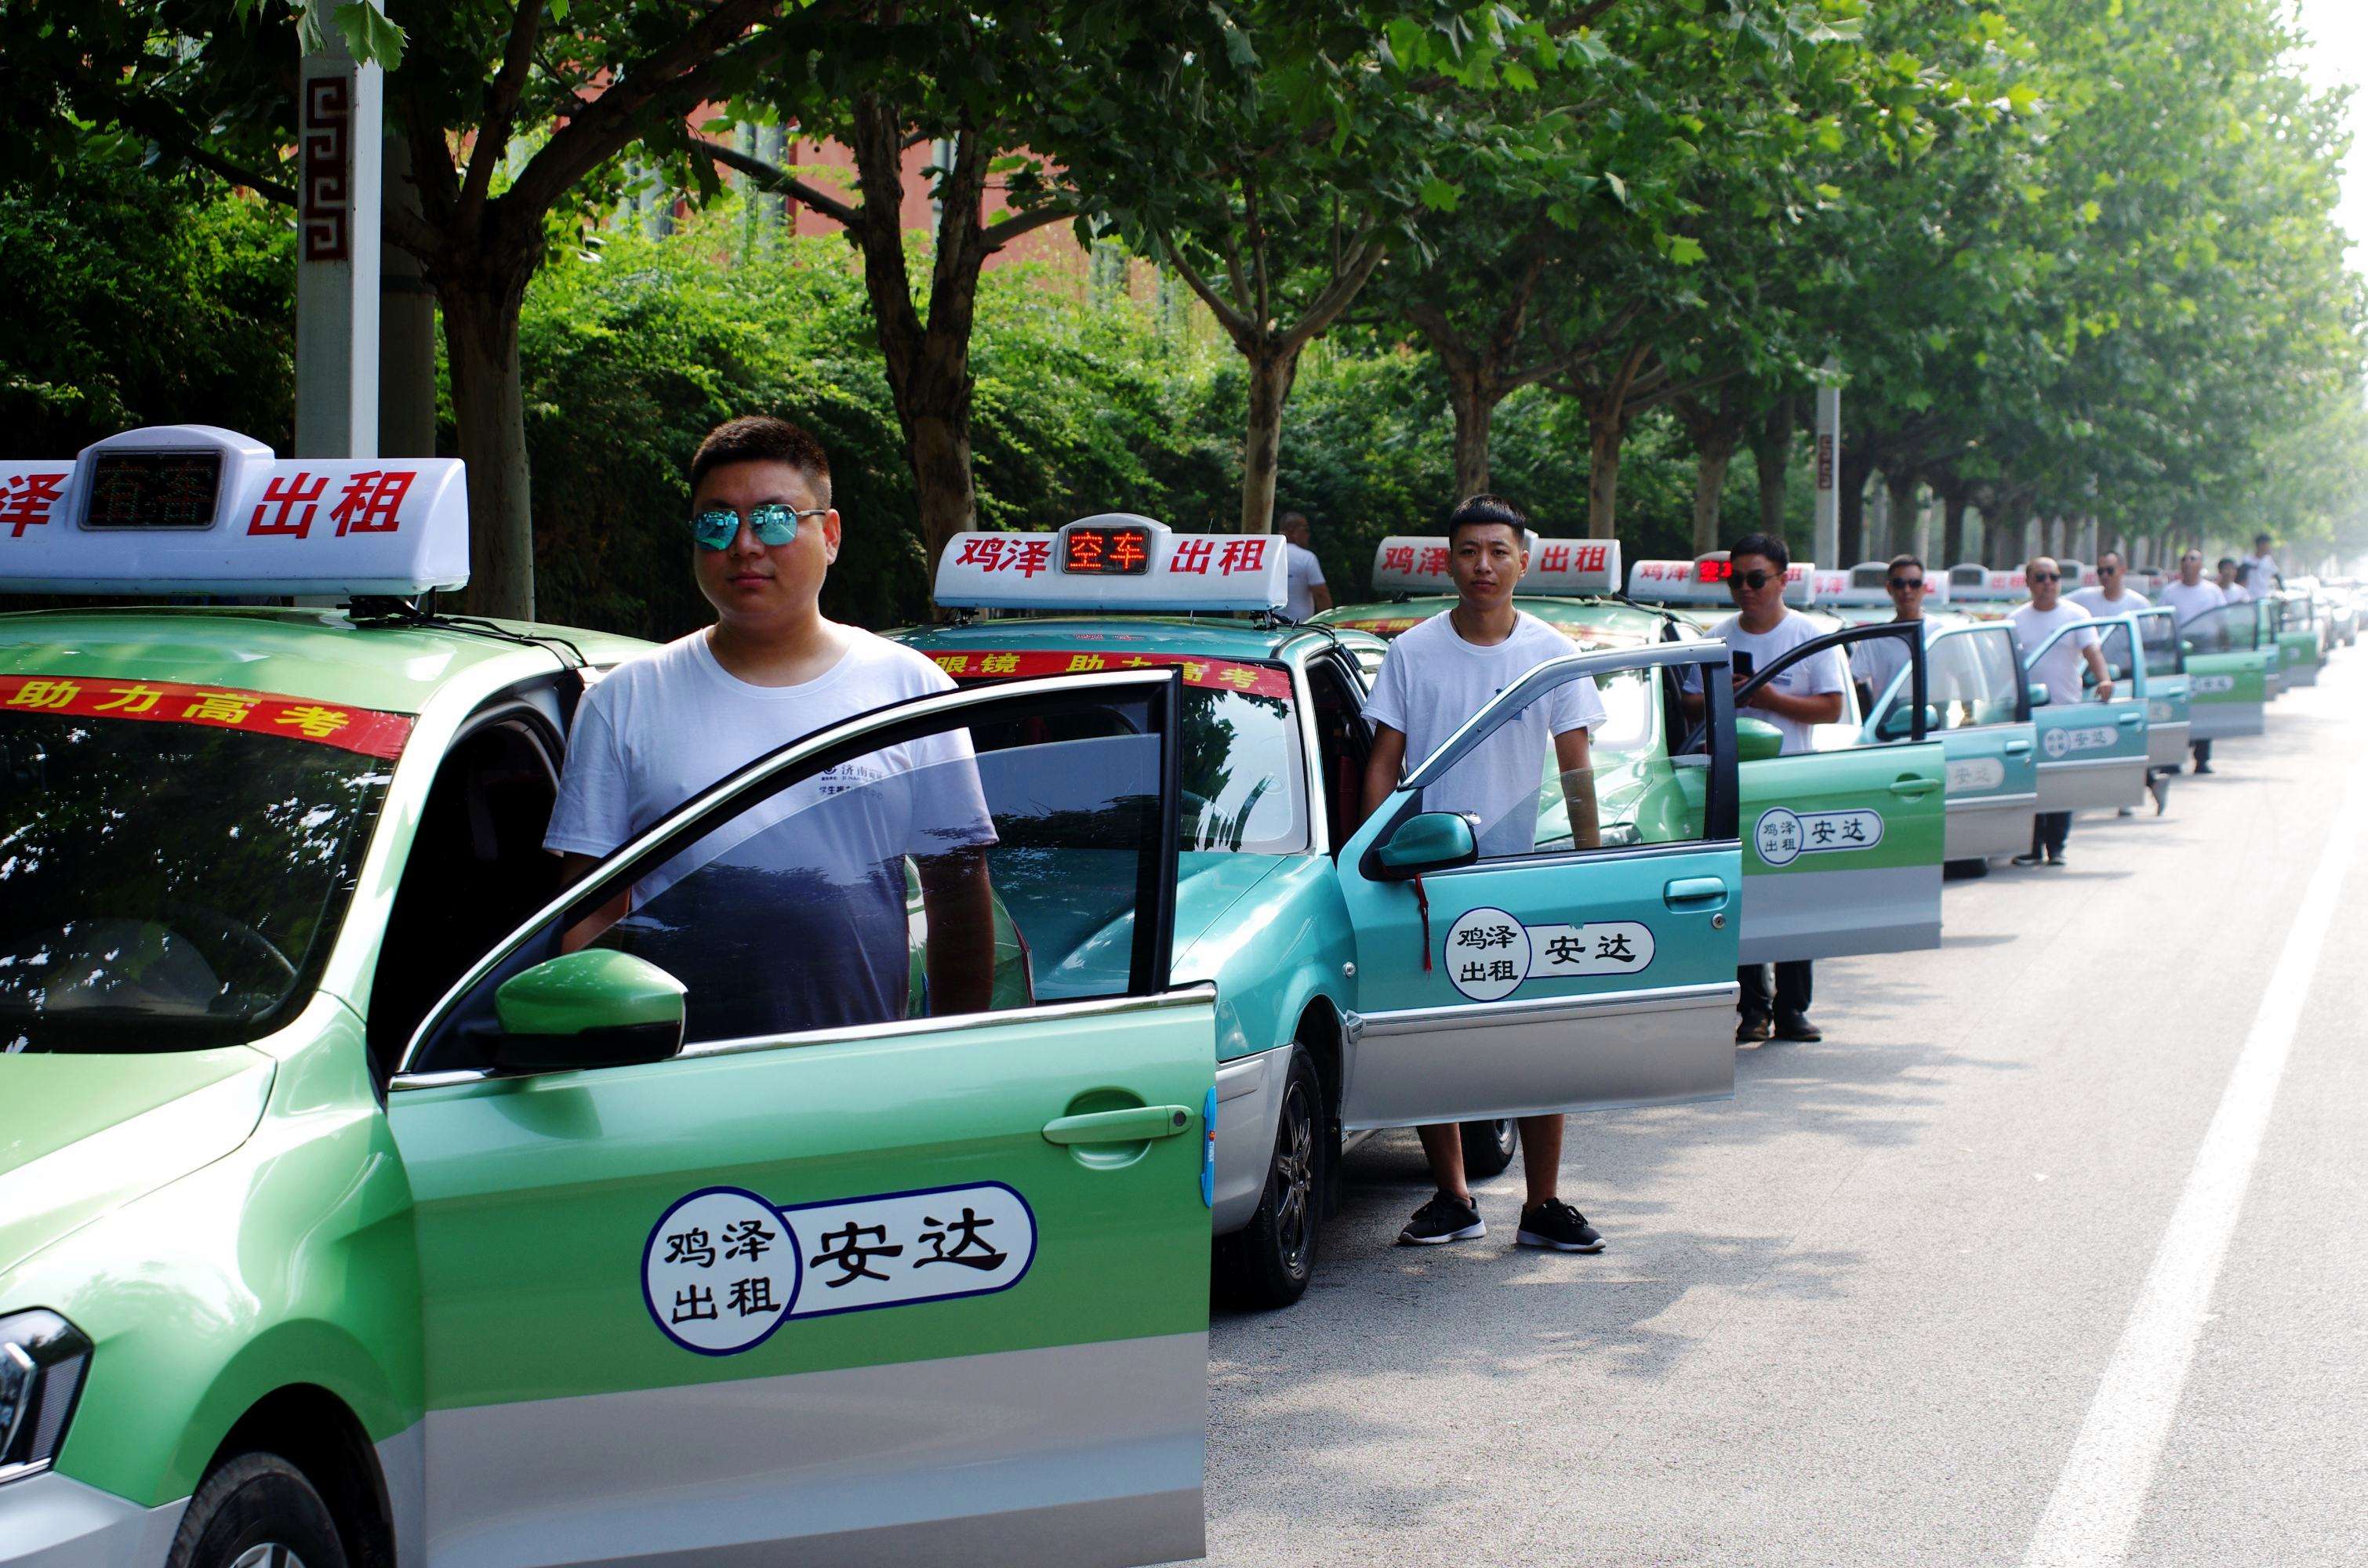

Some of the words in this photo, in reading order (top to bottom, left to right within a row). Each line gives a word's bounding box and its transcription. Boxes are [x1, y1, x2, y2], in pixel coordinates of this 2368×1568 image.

[247, 470, 417, 539] 出租
[956, 538, 1051, 579] 鸡泽
[1169, 539, 1267, 576] 出租
[1070, 532, 1145, 570] 空车
[1382, 546, 1451, 575] 鸡泽
[1540, 545, 1607, 573] 出租
[935, 652, 1020, 673] 眼镜
[6, 680, 351, 739] 助力高考
[1764, 821, 1796, 836] 鸡泽
[1812, 818, 1865, 844] 安达
[1765, 838, 1796, 852] 出租
[1457, 925, 1517, 950] 鸡泽
[1545, 933, 1636, 965] 安达
[1460, 960, 1518, 982] 出租
[664, 1221, 775, 1268] 鸡泽
[810, 1207, 1008, 1287] 安达
[671, 1277, 781, 1324] 出租
